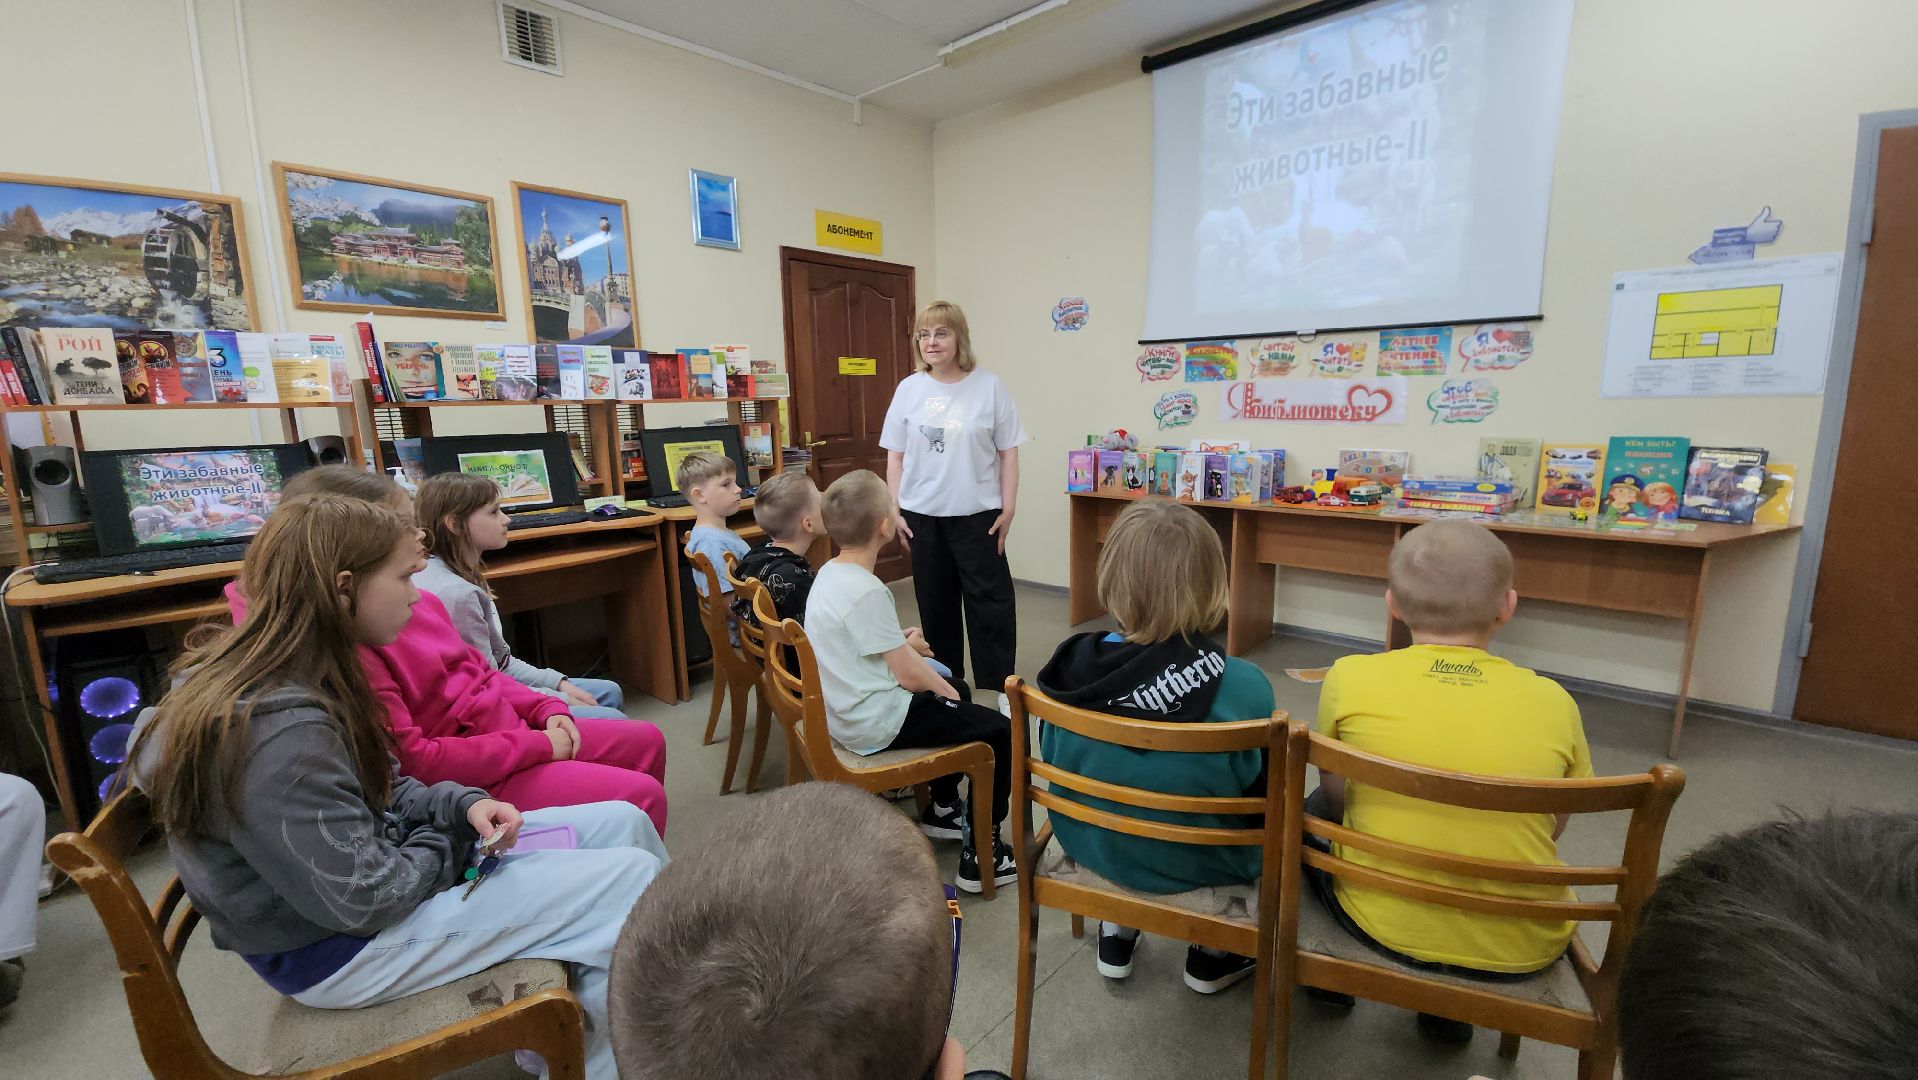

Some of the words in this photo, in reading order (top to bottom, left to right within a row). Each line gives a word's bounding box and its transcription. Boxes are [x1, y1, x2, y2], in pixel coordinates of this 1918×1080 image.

[1226, 92, 1275, 130] Эти
[1284, 44, 1450, 118] забавные
[826, 223, 874, 241] АБОНЕМЕНТ
[1476, 332, 1489, 347] Я
[1322, 342, 1334, 356] Я
[63, 386, 114, 396] ДОНБАССА
[75, 380, 98, 388] ТЕНИ
[1227, 382, 1255, 419] Я
[1250, 398, 1378, 421] библиотеку
[140, 467, 174, 481] Эти
[180, 463, 263, 479] забавные
[1701, 507, 1730, 516] ТЕХНИКА
[1430, 658, 1482, 676] Nevada
